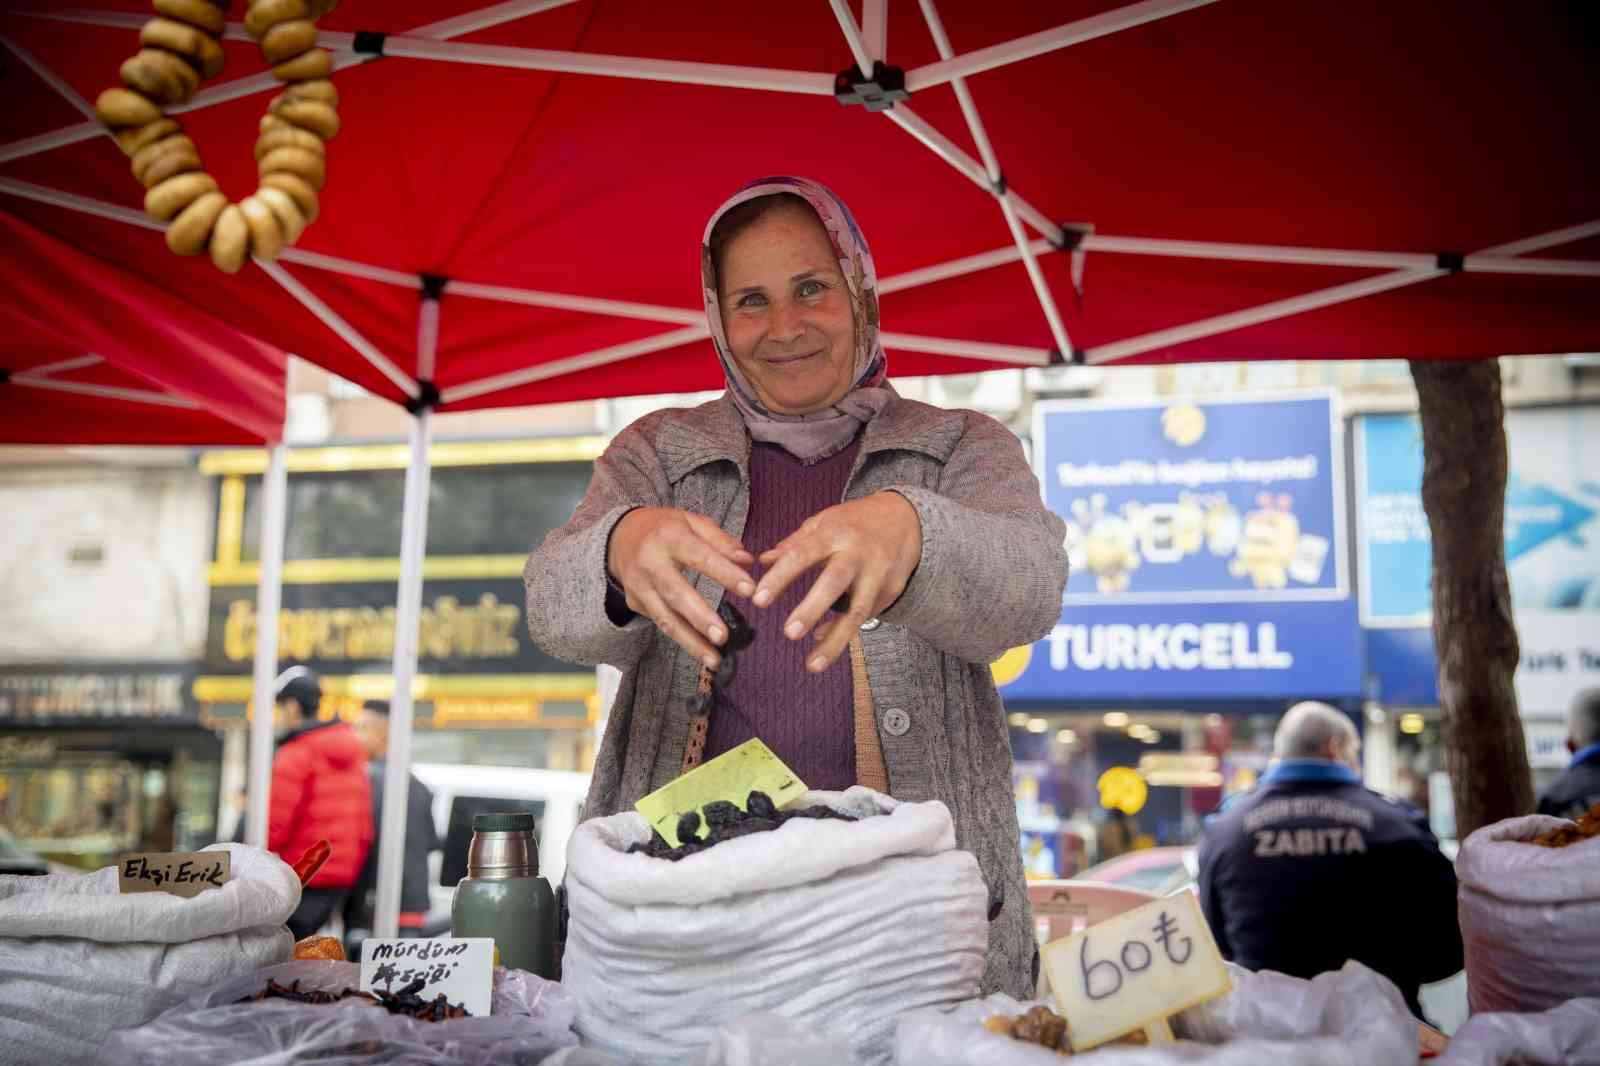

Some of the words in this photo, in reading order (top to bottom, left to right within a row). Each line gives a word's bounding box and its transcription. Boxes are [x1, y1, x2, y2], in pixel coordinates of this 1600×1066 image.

[1048, 622, 1293, 671] TURKCELL
[1254, 828, 1367, 856] ZABITA
[174, 861, 223, 886] Erik
